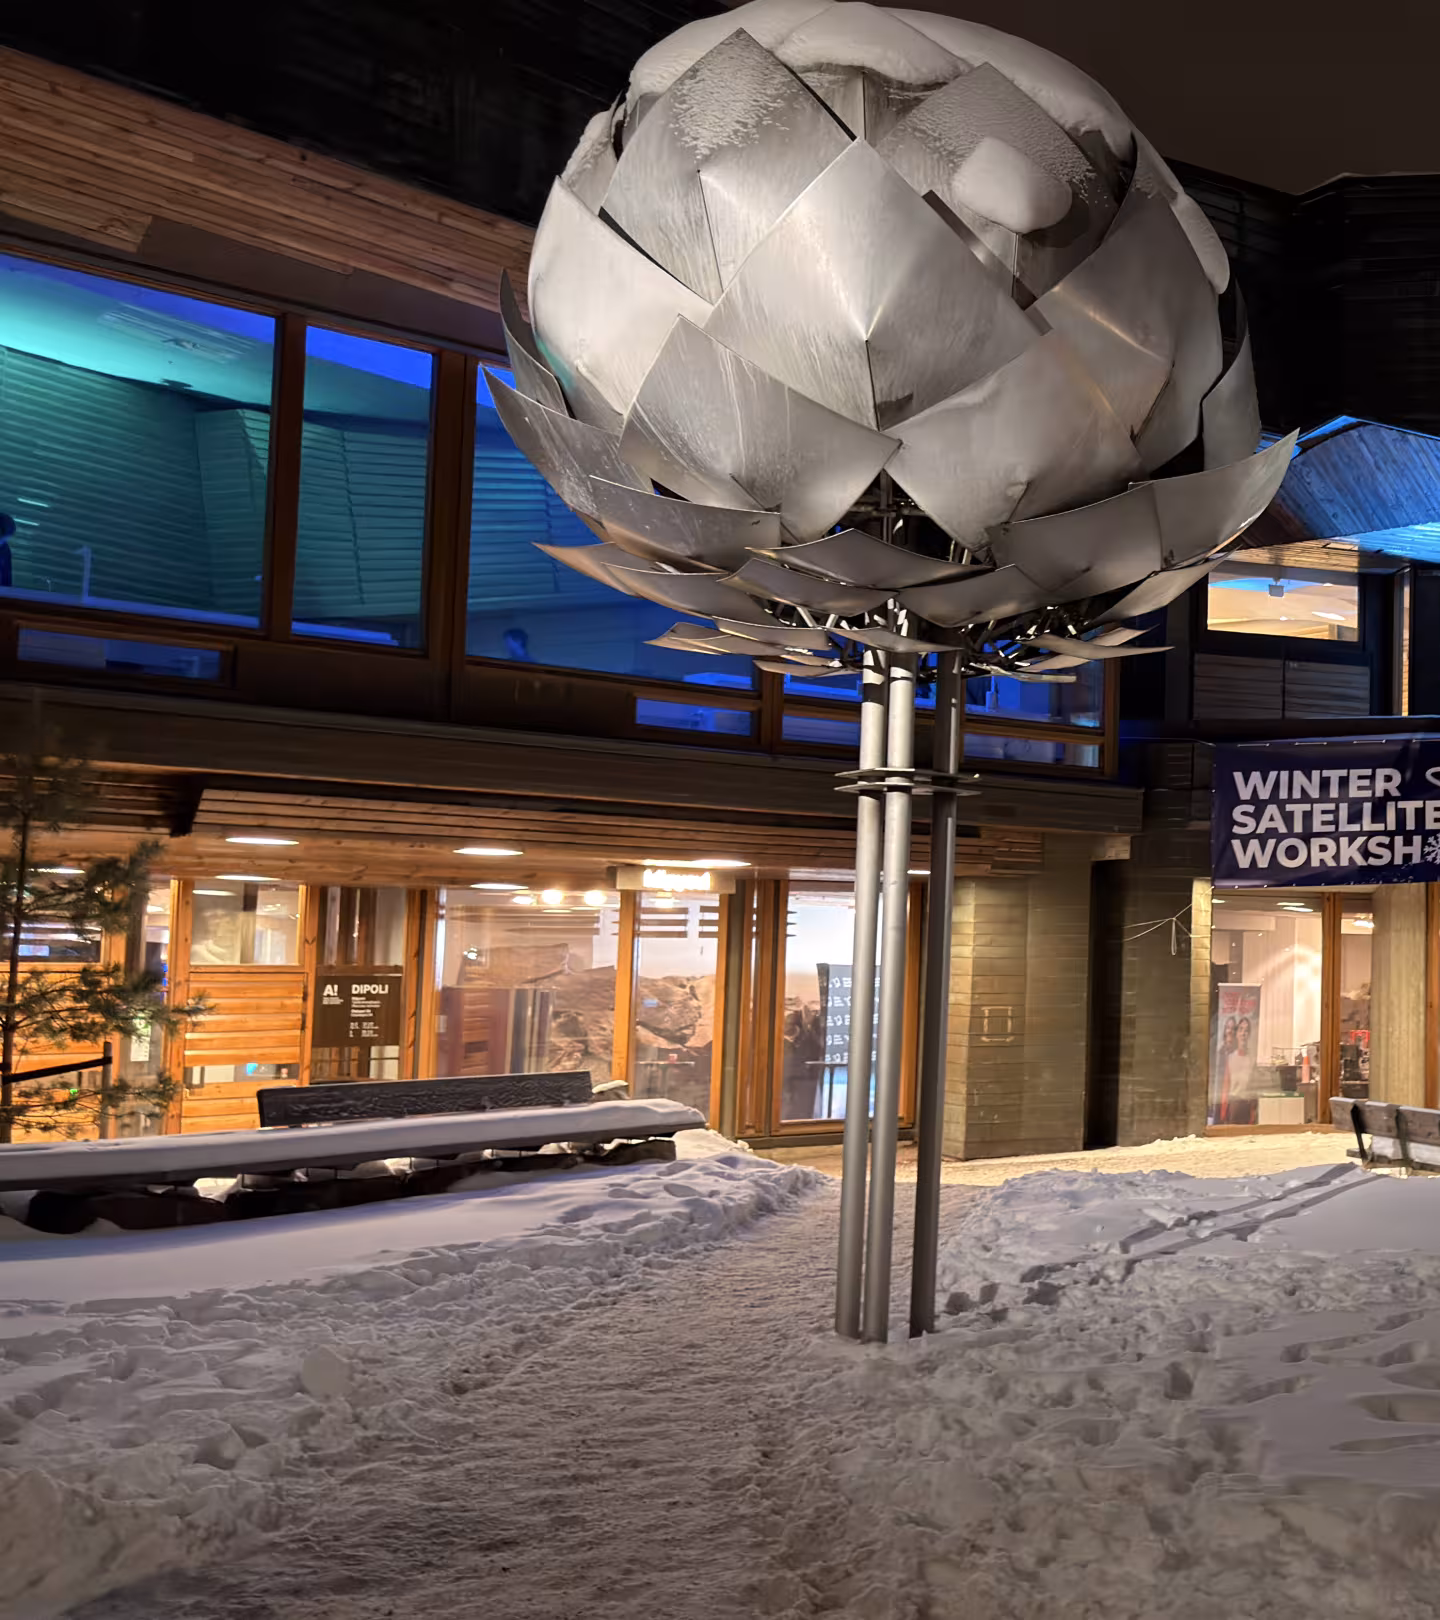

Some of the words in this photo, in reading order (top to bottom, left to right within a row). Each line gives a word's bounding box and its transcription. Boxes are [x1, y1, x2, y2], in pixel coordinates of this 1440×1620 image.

[1233, 768, 1402, 800] WINTER
[322, 984, 338, 996] A!
[351, 984, 389, 995] DIPOLI
